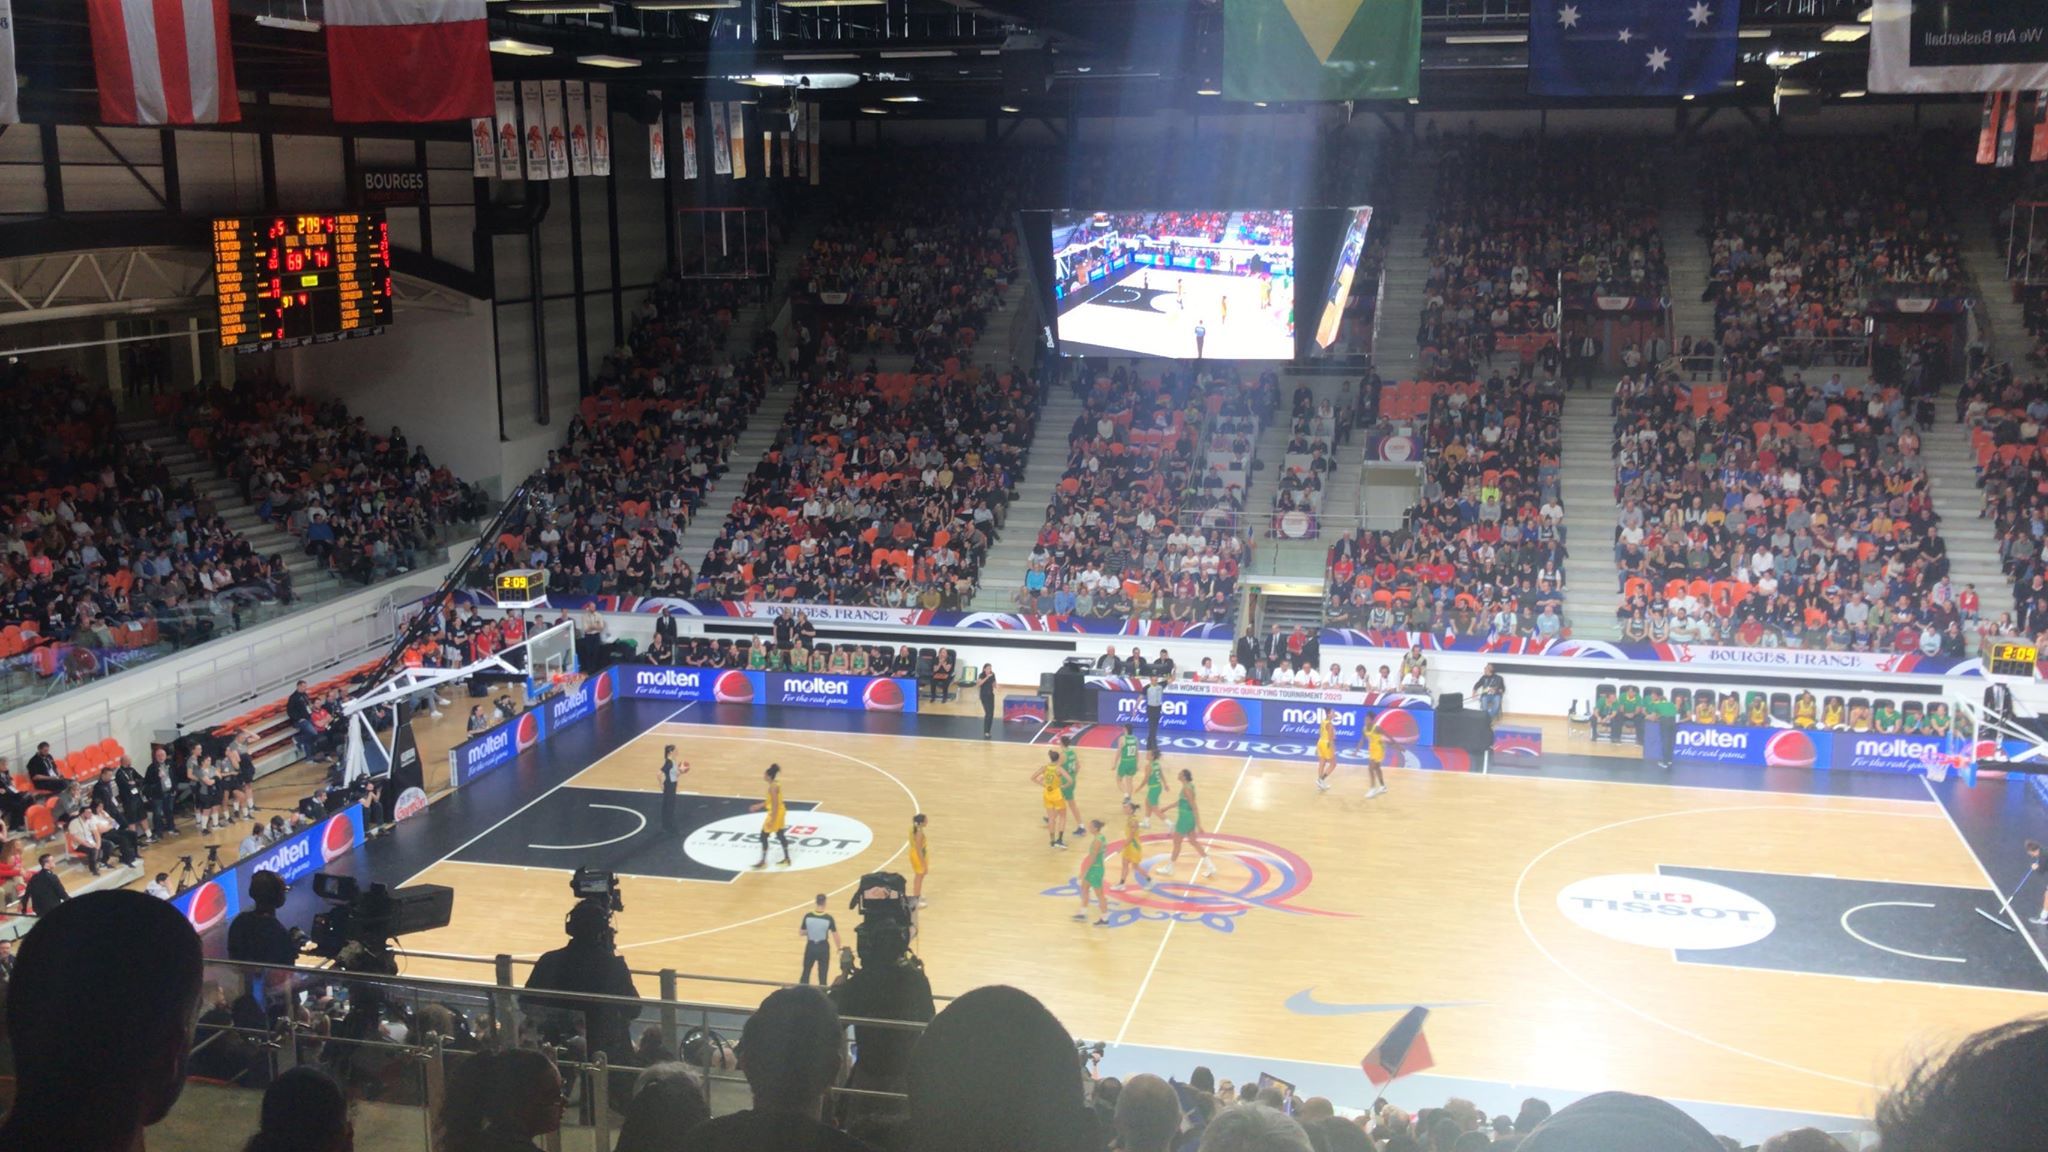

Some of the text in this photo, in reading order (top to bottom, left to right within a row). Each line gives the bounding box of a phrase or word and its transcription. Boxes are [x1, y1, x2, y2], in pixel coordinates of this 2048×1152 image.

[365, 174, 424, 189] BOURGES
[315, 252, 328, 268] 74
[504, 577, 526, 588] 2:09
[834, 608, 889, 622] FRANCE
[1794, 653, 1862, 667] FRANCE
[2002, 646, 2036, 662] 2:09
[637, 670, 700, 688] molten
[784, 678, 848, 694] molten
[635, 686, 648, 694] For
[648, 687, 660, 695] the
[782, 694, 794, 702] For
[796, 694, 808, 702] the
[468, 731, 508, 764] molten
[1855, 739, 1938, 758] molten
[1851, 756, 1868, 767] For
[1868, 757, 1886, 768] the
[1570, 896, 1760, 922] TISSOT
